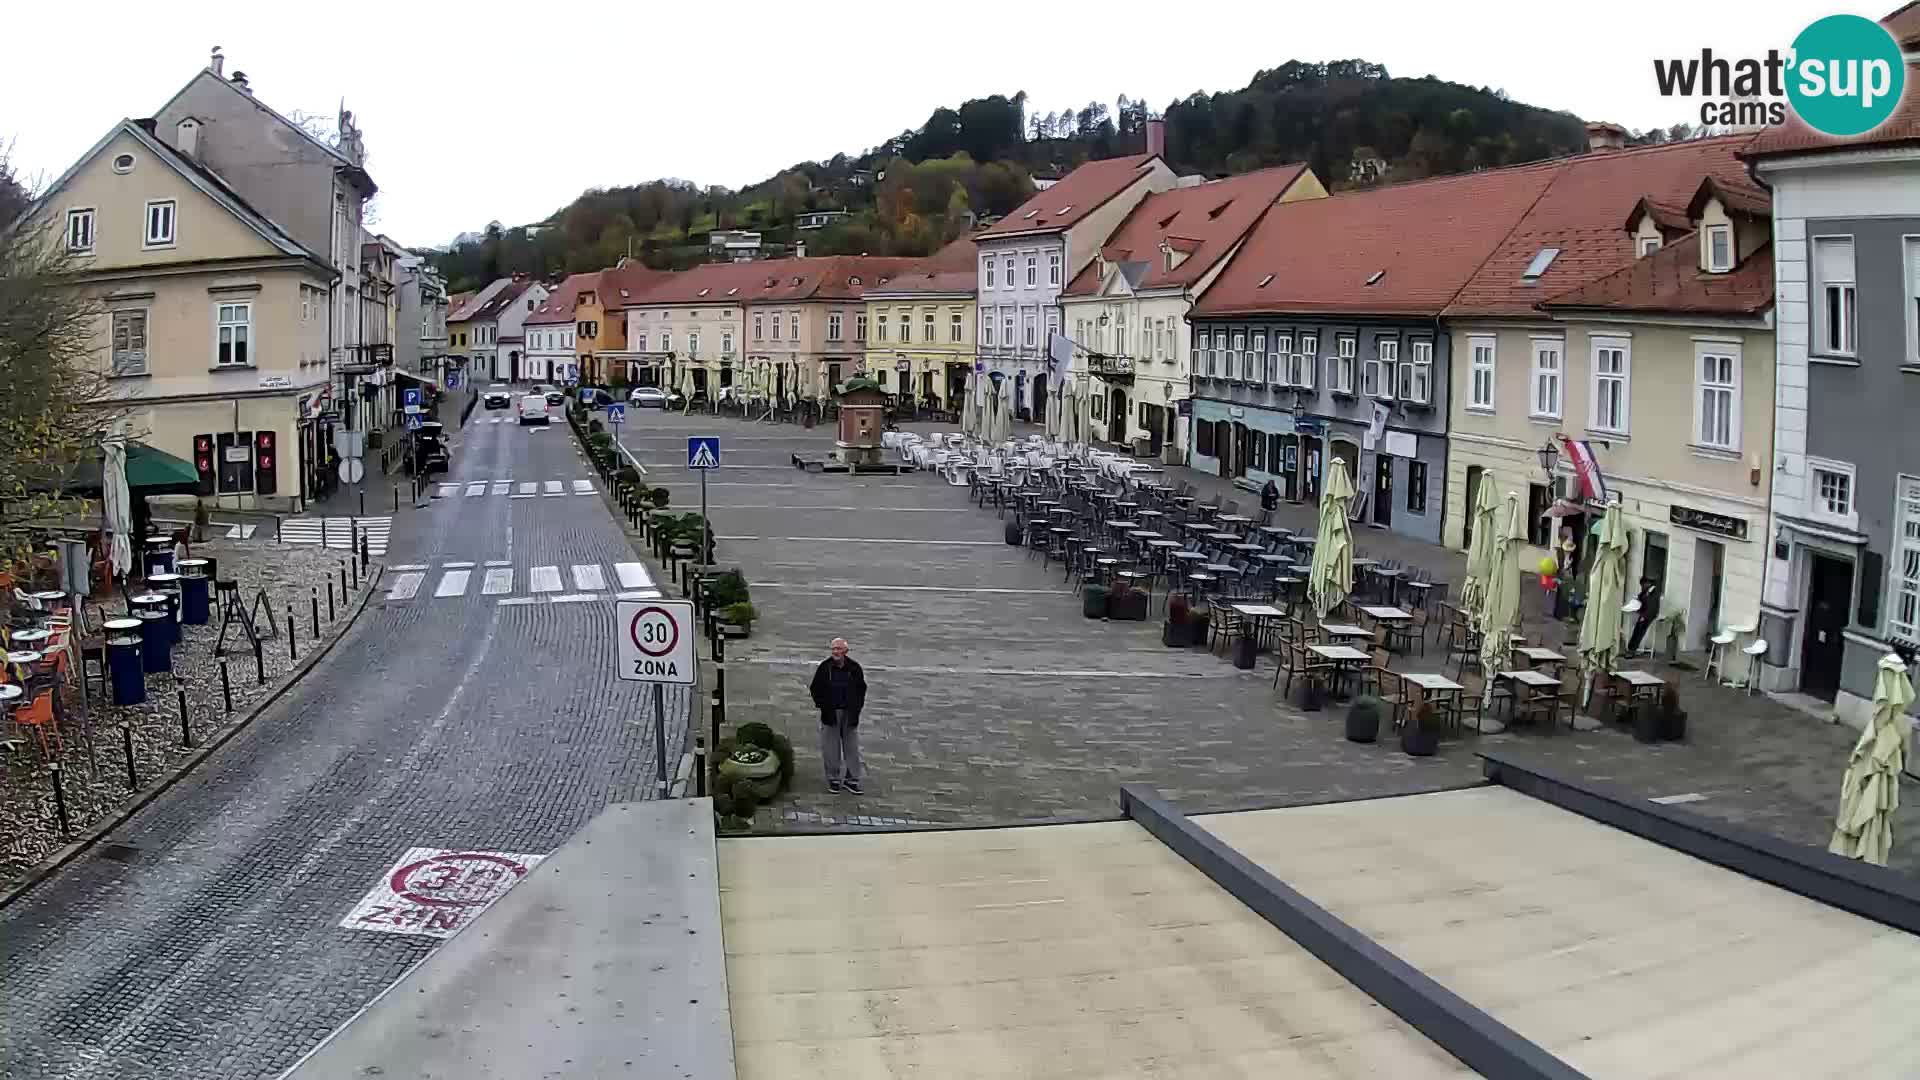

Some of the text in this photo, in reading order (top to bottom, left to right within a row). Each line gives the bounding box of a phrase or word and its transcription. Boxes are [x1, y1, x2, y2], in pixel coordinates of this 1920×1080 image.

[408, 392, 416, 402] P
[643, 622, 667, 643] 30
[633, 660, 678, 677] ZONA
